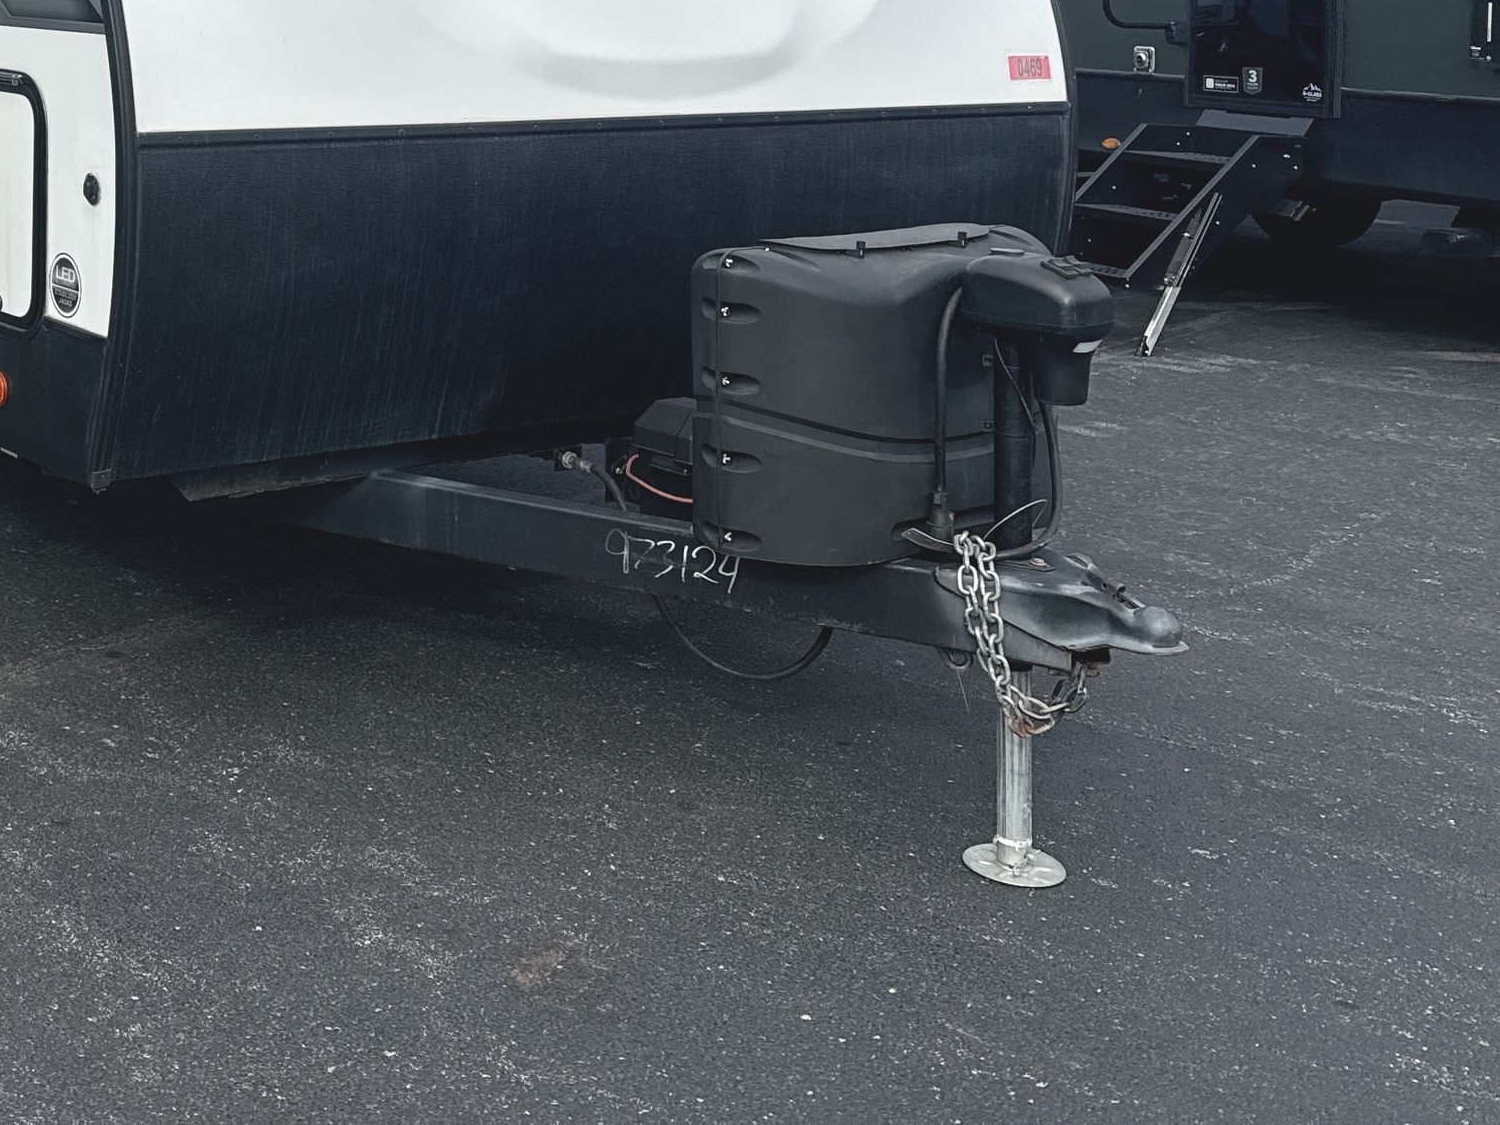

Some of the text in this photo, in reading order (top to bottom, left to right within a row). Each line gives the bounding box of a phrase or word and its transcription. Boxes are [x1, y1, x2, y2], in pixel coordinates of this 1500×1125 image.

[1248, 69, 1258, 83] 3
[55, 264, 76, 283] LED
[605, 528, 740, 594] 973124
